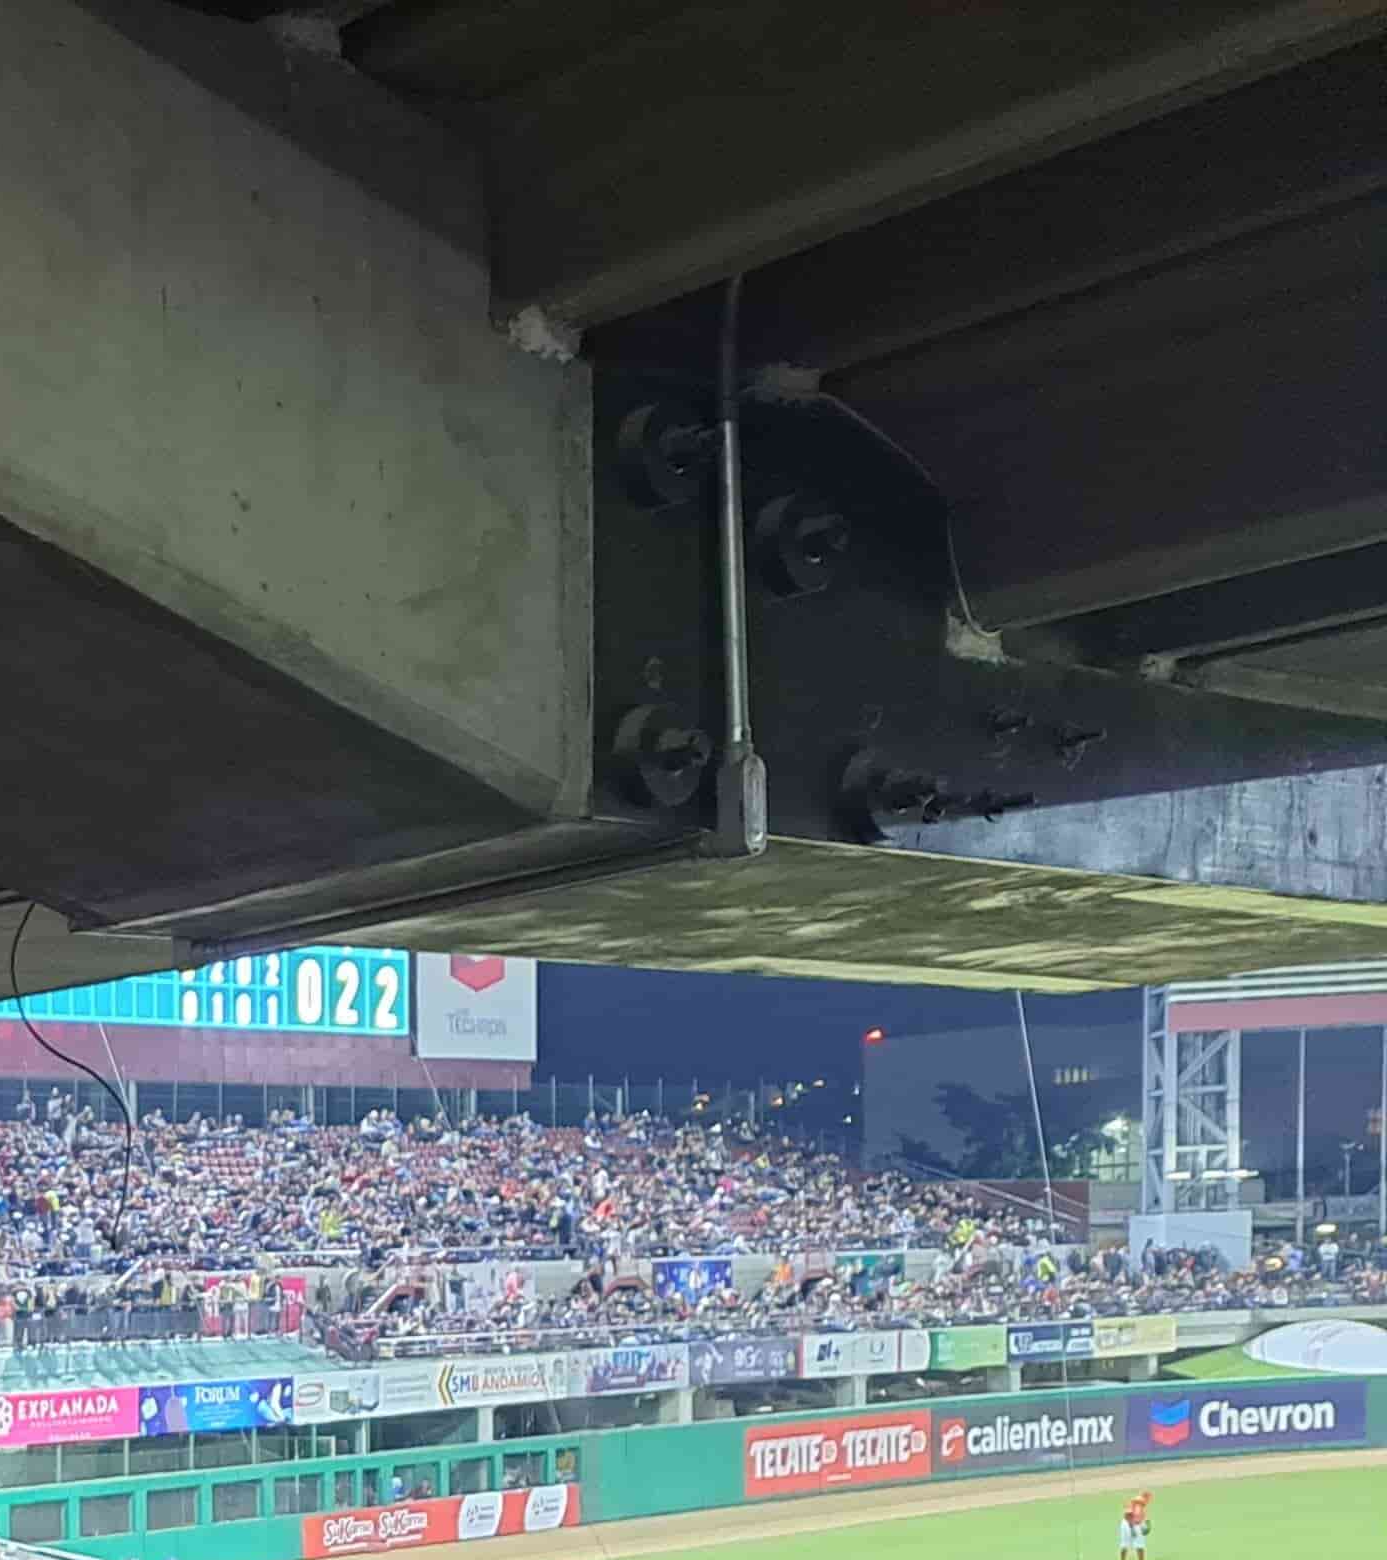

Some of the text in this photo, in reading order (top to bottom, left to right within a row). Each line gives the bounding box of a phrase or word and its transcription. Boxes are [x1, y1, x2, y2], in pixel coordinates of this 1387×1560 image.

[18, 1395, 118, 1420] EXPLANADA
[1199, 1400, 1334, 1437] Chevron
[749, 1424, 912, 1480] TECATE TECATE
[967, 1415, 1113, 1455] caliente.mx
